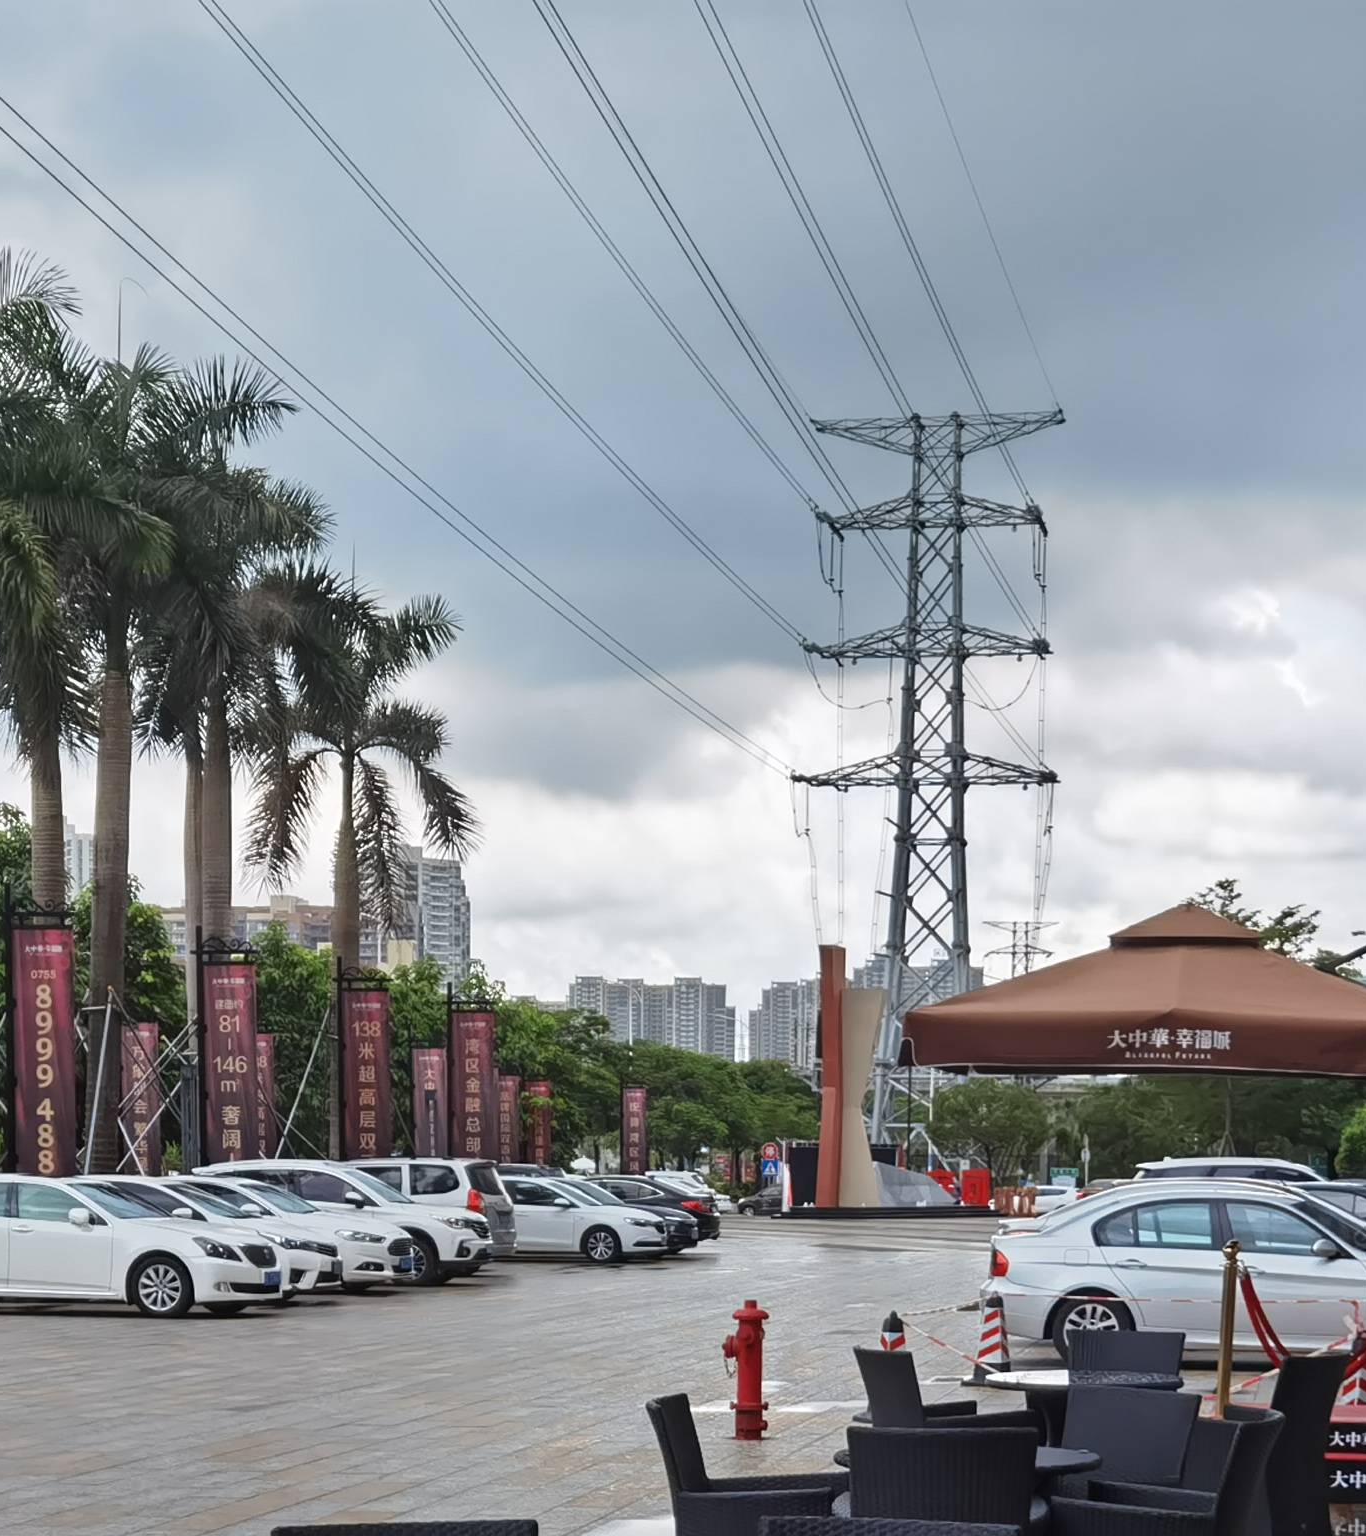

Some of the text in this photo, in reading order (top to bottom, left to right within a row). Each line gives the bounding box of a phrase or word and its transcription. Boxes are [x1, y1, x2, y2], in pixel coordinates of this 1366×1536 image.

[30, 969, 57, 980] 0755
[219, 1015, 240, 1033] 81
[352, 1021, 381, 1037] 138
[36, 984, 54, 1088] 8999
[1107, 1028, 1232, 1050] 大中華·幸福城
[213, 1056, 248, 1073] 146
[358, 1043, 377, 1157] 米超高层双
[465, 1038, 481, 1153] 湾区金融总部
[221, 1105, 241, 1161] 奢阔
